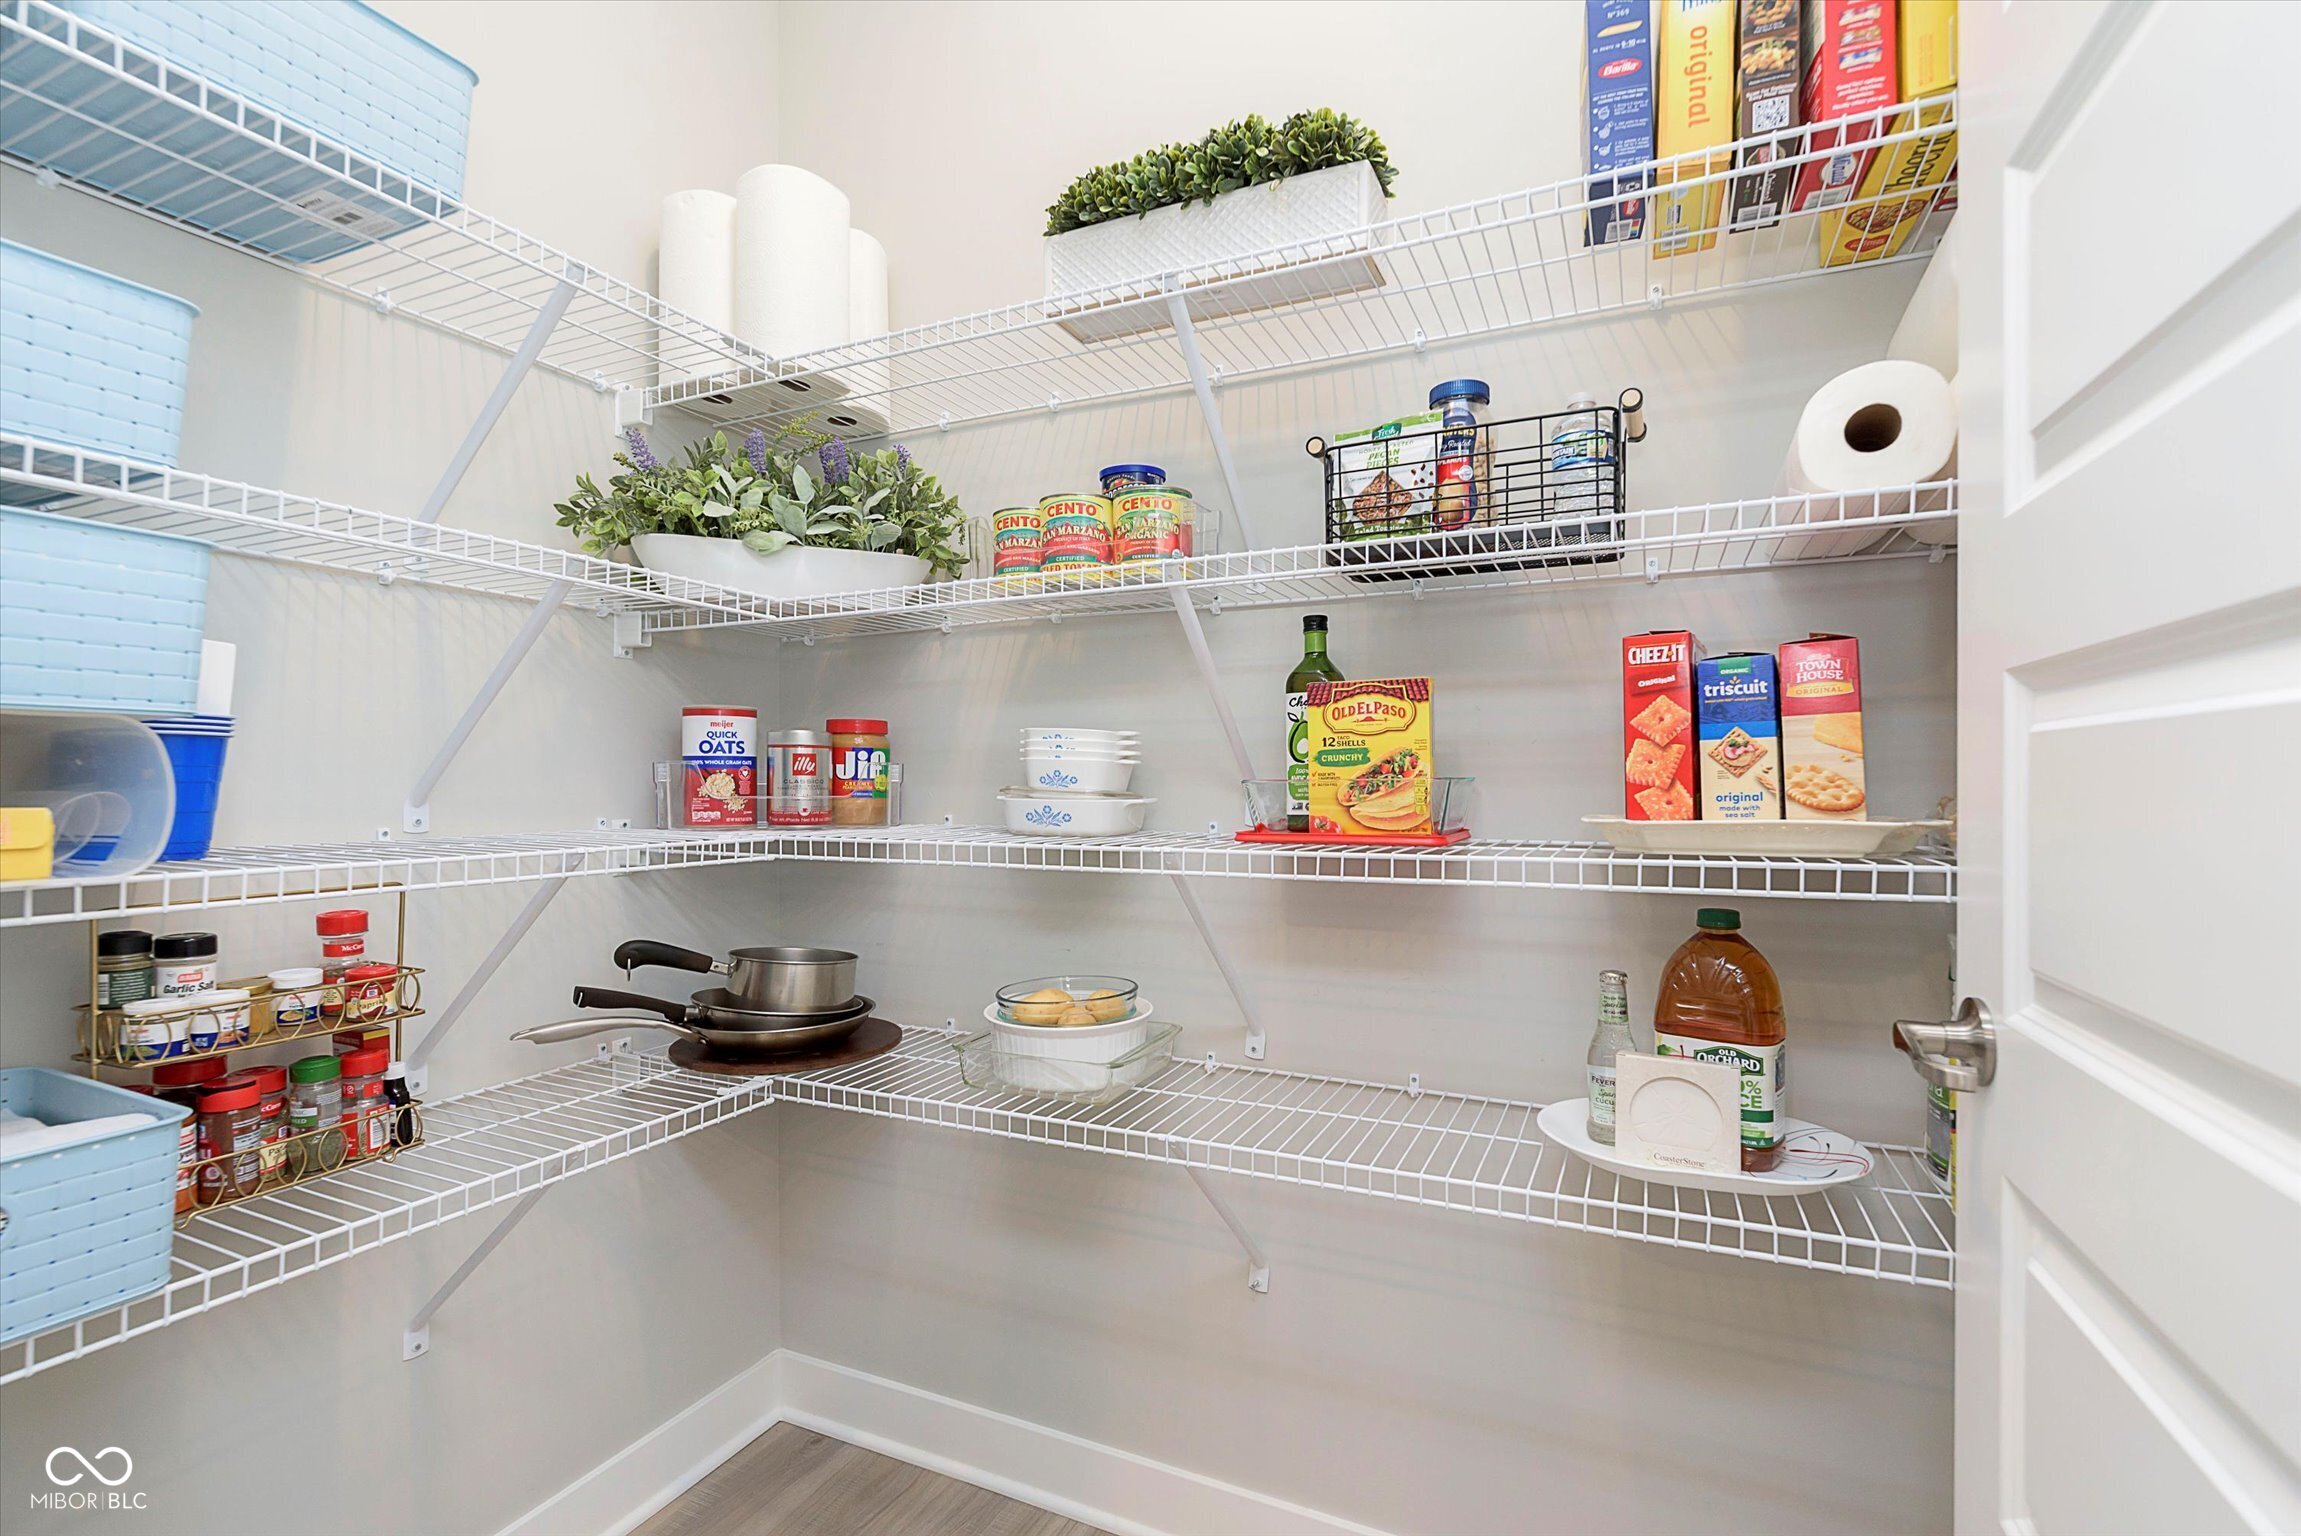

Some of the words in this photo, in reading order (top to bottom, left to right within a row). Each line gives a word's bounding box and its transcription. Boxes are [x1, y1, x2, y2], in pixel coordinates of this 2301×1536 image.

[1603, 62, 1639, 77] Barilla
[1684, 25, 1713, 128] original
[1047, 502, 1097, 518] CENTO
[1122, 496, 1172, 512] CENTO
[997, 515, 1041, 531] CENTO
[1060, 525, 1106, 542] MARZANO
[1125, 529, 1169, 540] ORGANIC
[1720, 667, 1749, 675] ORGANIC
[1796, 658, 1842, 672] TOWN
[1796, 669, 1844, 683] HOUSE
[1703, 679, 1768, 697] triscuit
[1795, 686, 1844, 695] ORIGINAL
[1332, 704, 1356, 721] OLD
[1357, 702, 1373, 715] EL
[710, 719, 734, 729] meijer
[706, 730, 738, 740] QUICK
[1322, 737, 1336, 747] 12
[699, 739, 745, 754] OATS
[793, 756, 816, 774] illy
[835, 750, 887, 780] Jif
[1321, 753, 1364, 763] CRUNCHY
[1716, 791, 1763, 804] original
[163, 984, 195, 994] Garlic
[1718, 1048, 1737, 1057] OLD
[1696, 1052, 1760, 1072] ORCHARD
[1653, 1152, 1705, 1168] CoasterStone
